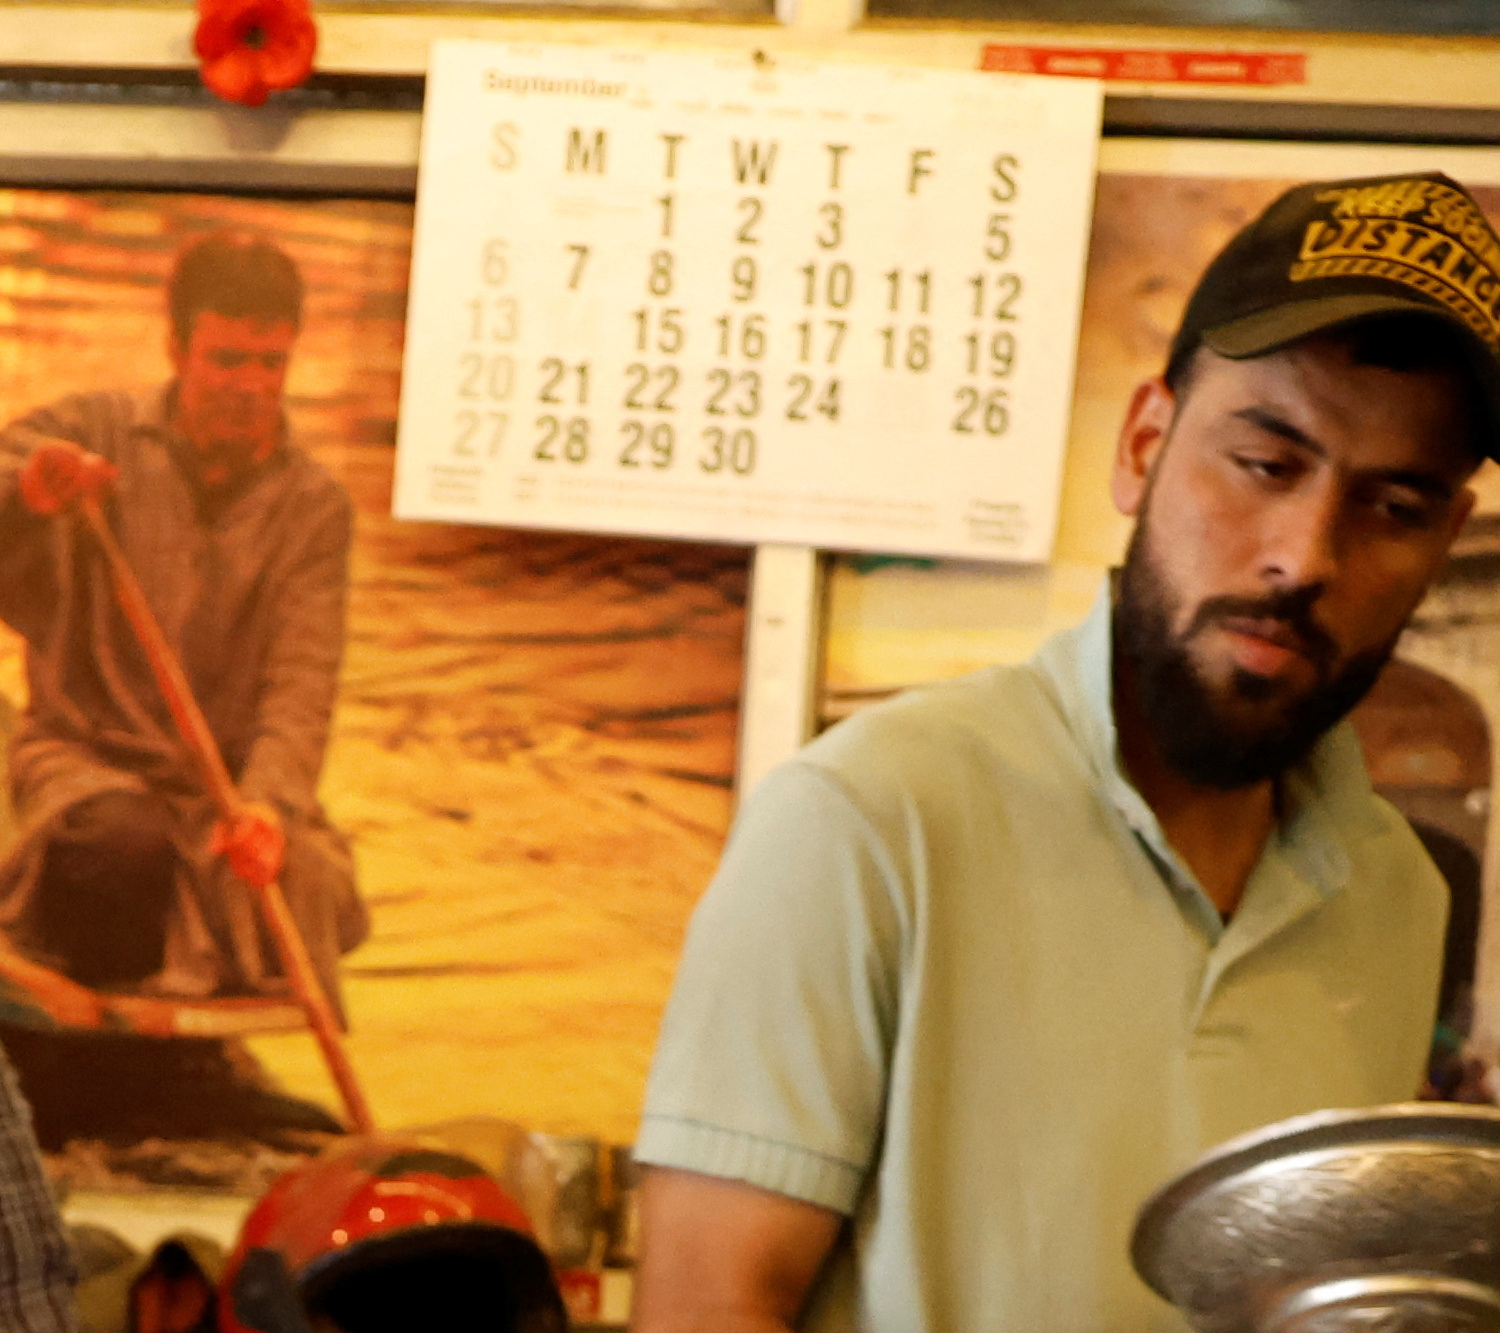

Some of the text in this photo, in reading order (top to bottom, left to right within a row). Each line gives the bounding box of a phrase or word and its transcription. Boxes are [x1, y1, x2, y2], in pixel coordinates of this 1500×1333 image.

[482, 68, 628, 98] September
[489, 121, 1019, 204] S M T W T F S
[657, 192, 1011, 262] 1 2 3 5
[480, 237, 1023, 322] 6 7 8 9 10 11 12
[466, 296, 1016, 379] 13 15 16 17 18 19
[457, 352, 1009, 437] 20 21 22 23 24 26
[452, 409, 757, 477] 27 28 29 30
